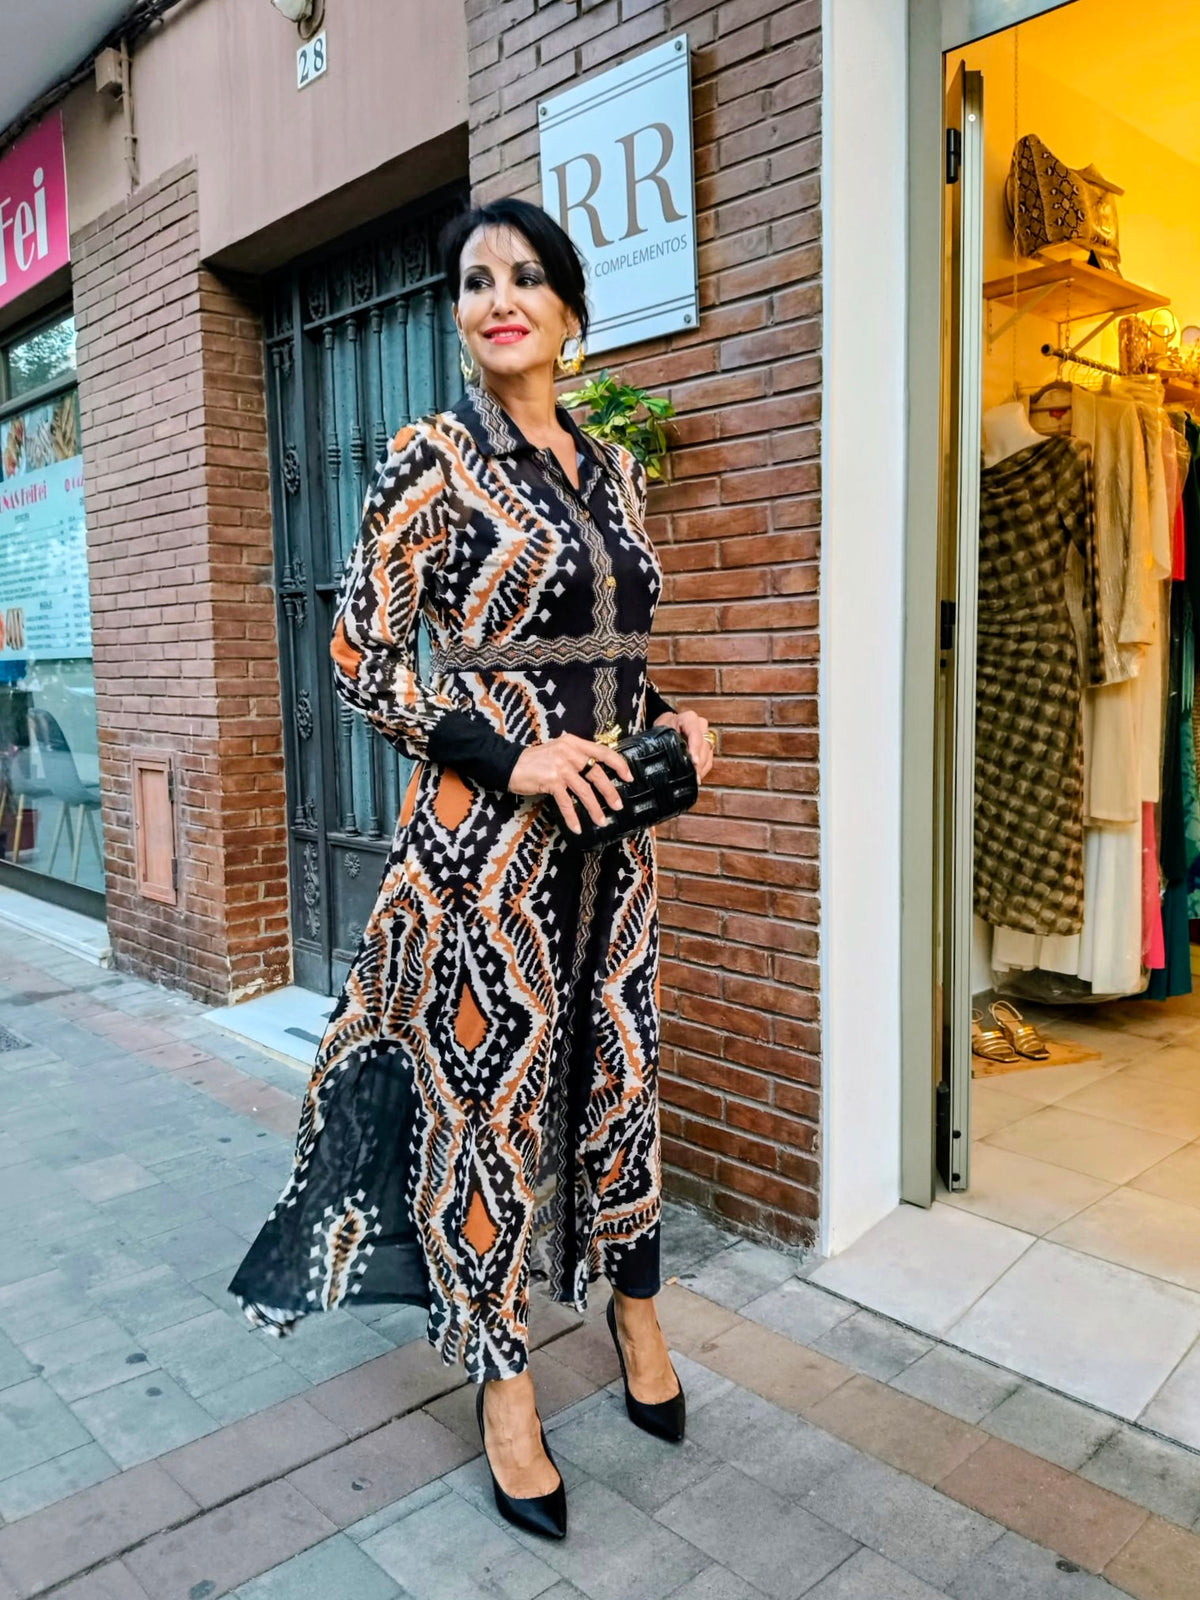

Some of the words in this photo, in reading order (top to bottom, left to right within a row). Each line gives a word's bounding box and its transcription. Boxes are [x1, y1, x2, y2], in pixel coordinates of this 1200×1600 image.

[299, 38, 324, 84] 28
[548, 122, 687, 248] RR
[594, 233, 688, 278] COMPLEMENTOS
